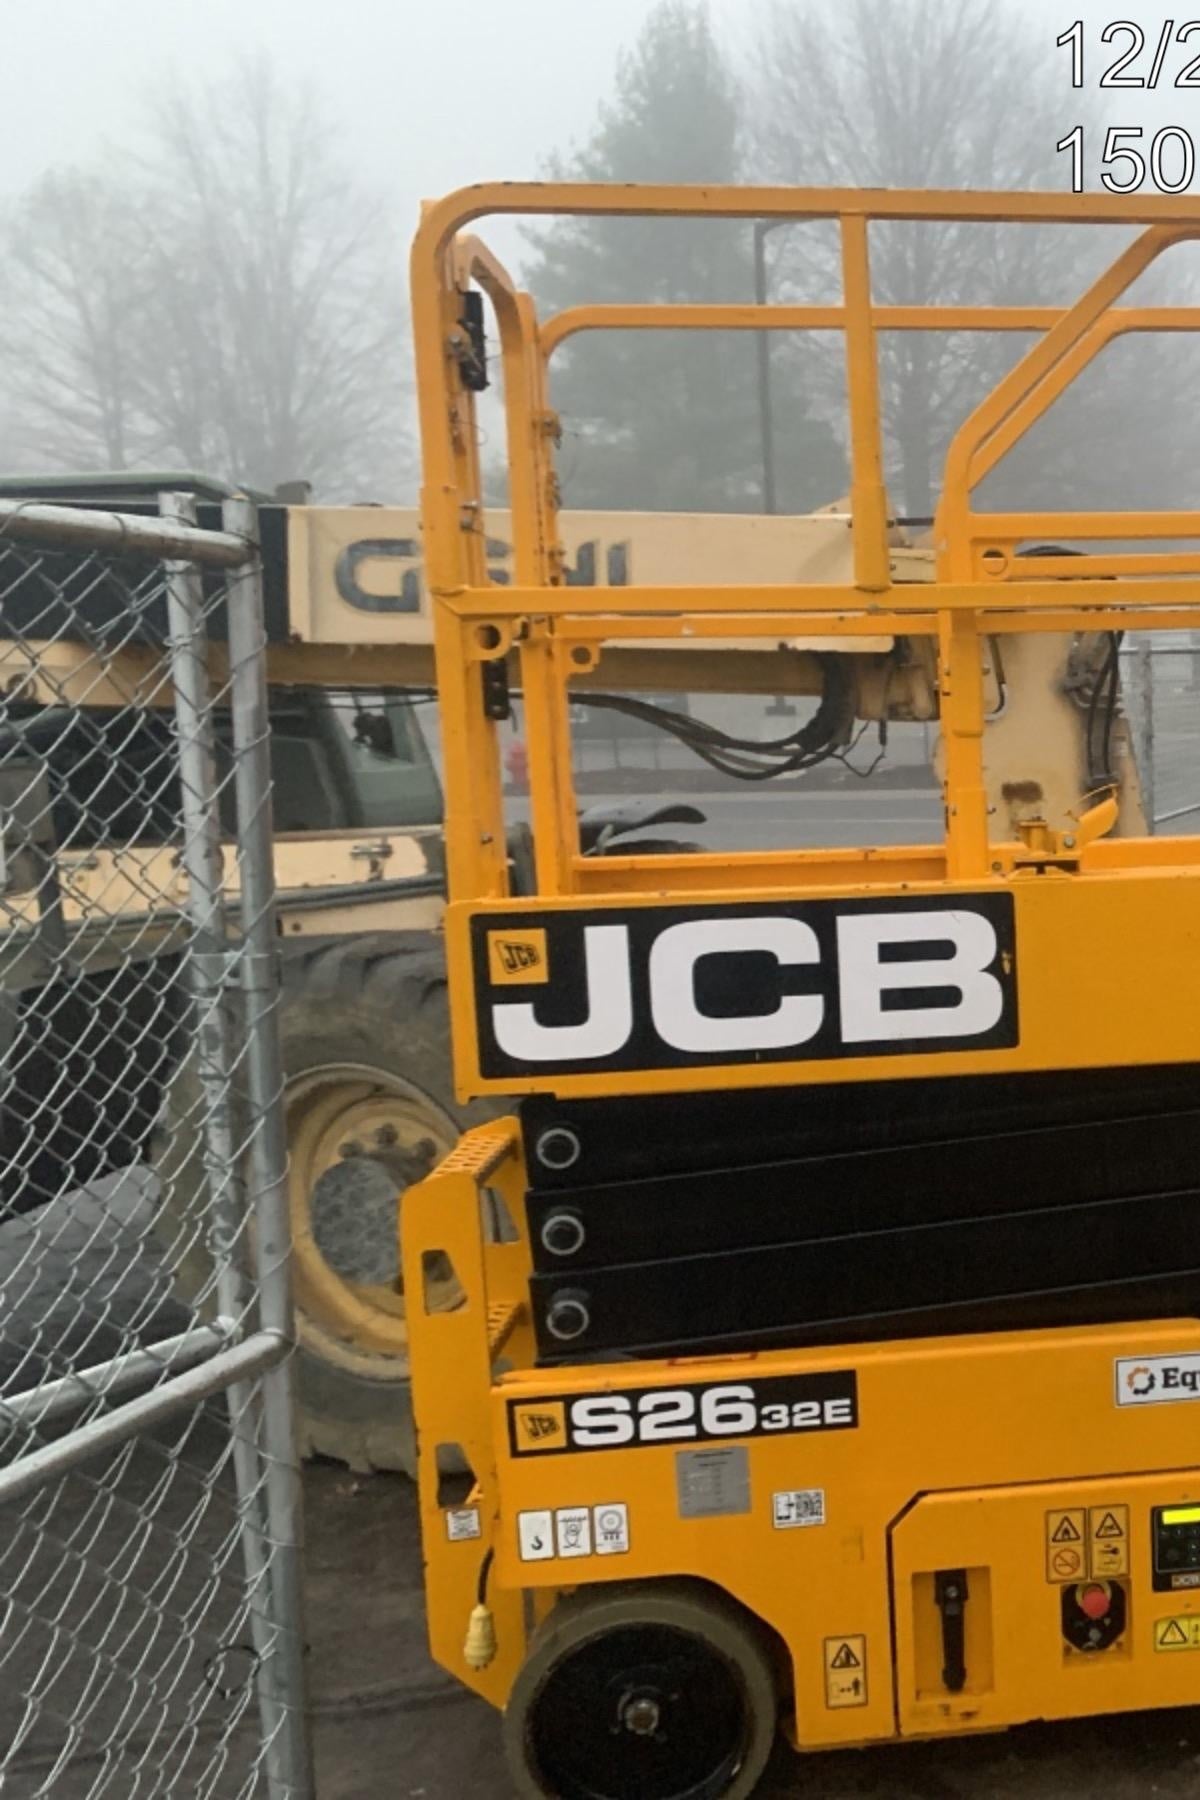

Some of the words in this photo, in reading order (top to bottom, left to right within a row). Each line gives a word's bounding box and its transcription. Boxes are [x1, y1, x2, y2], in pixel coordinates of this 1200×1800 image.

[491, 910, 1004, 1062] JCB
[571, 1385, 757, 1448] S26
[761, 1399, 853, 1430] 32E
